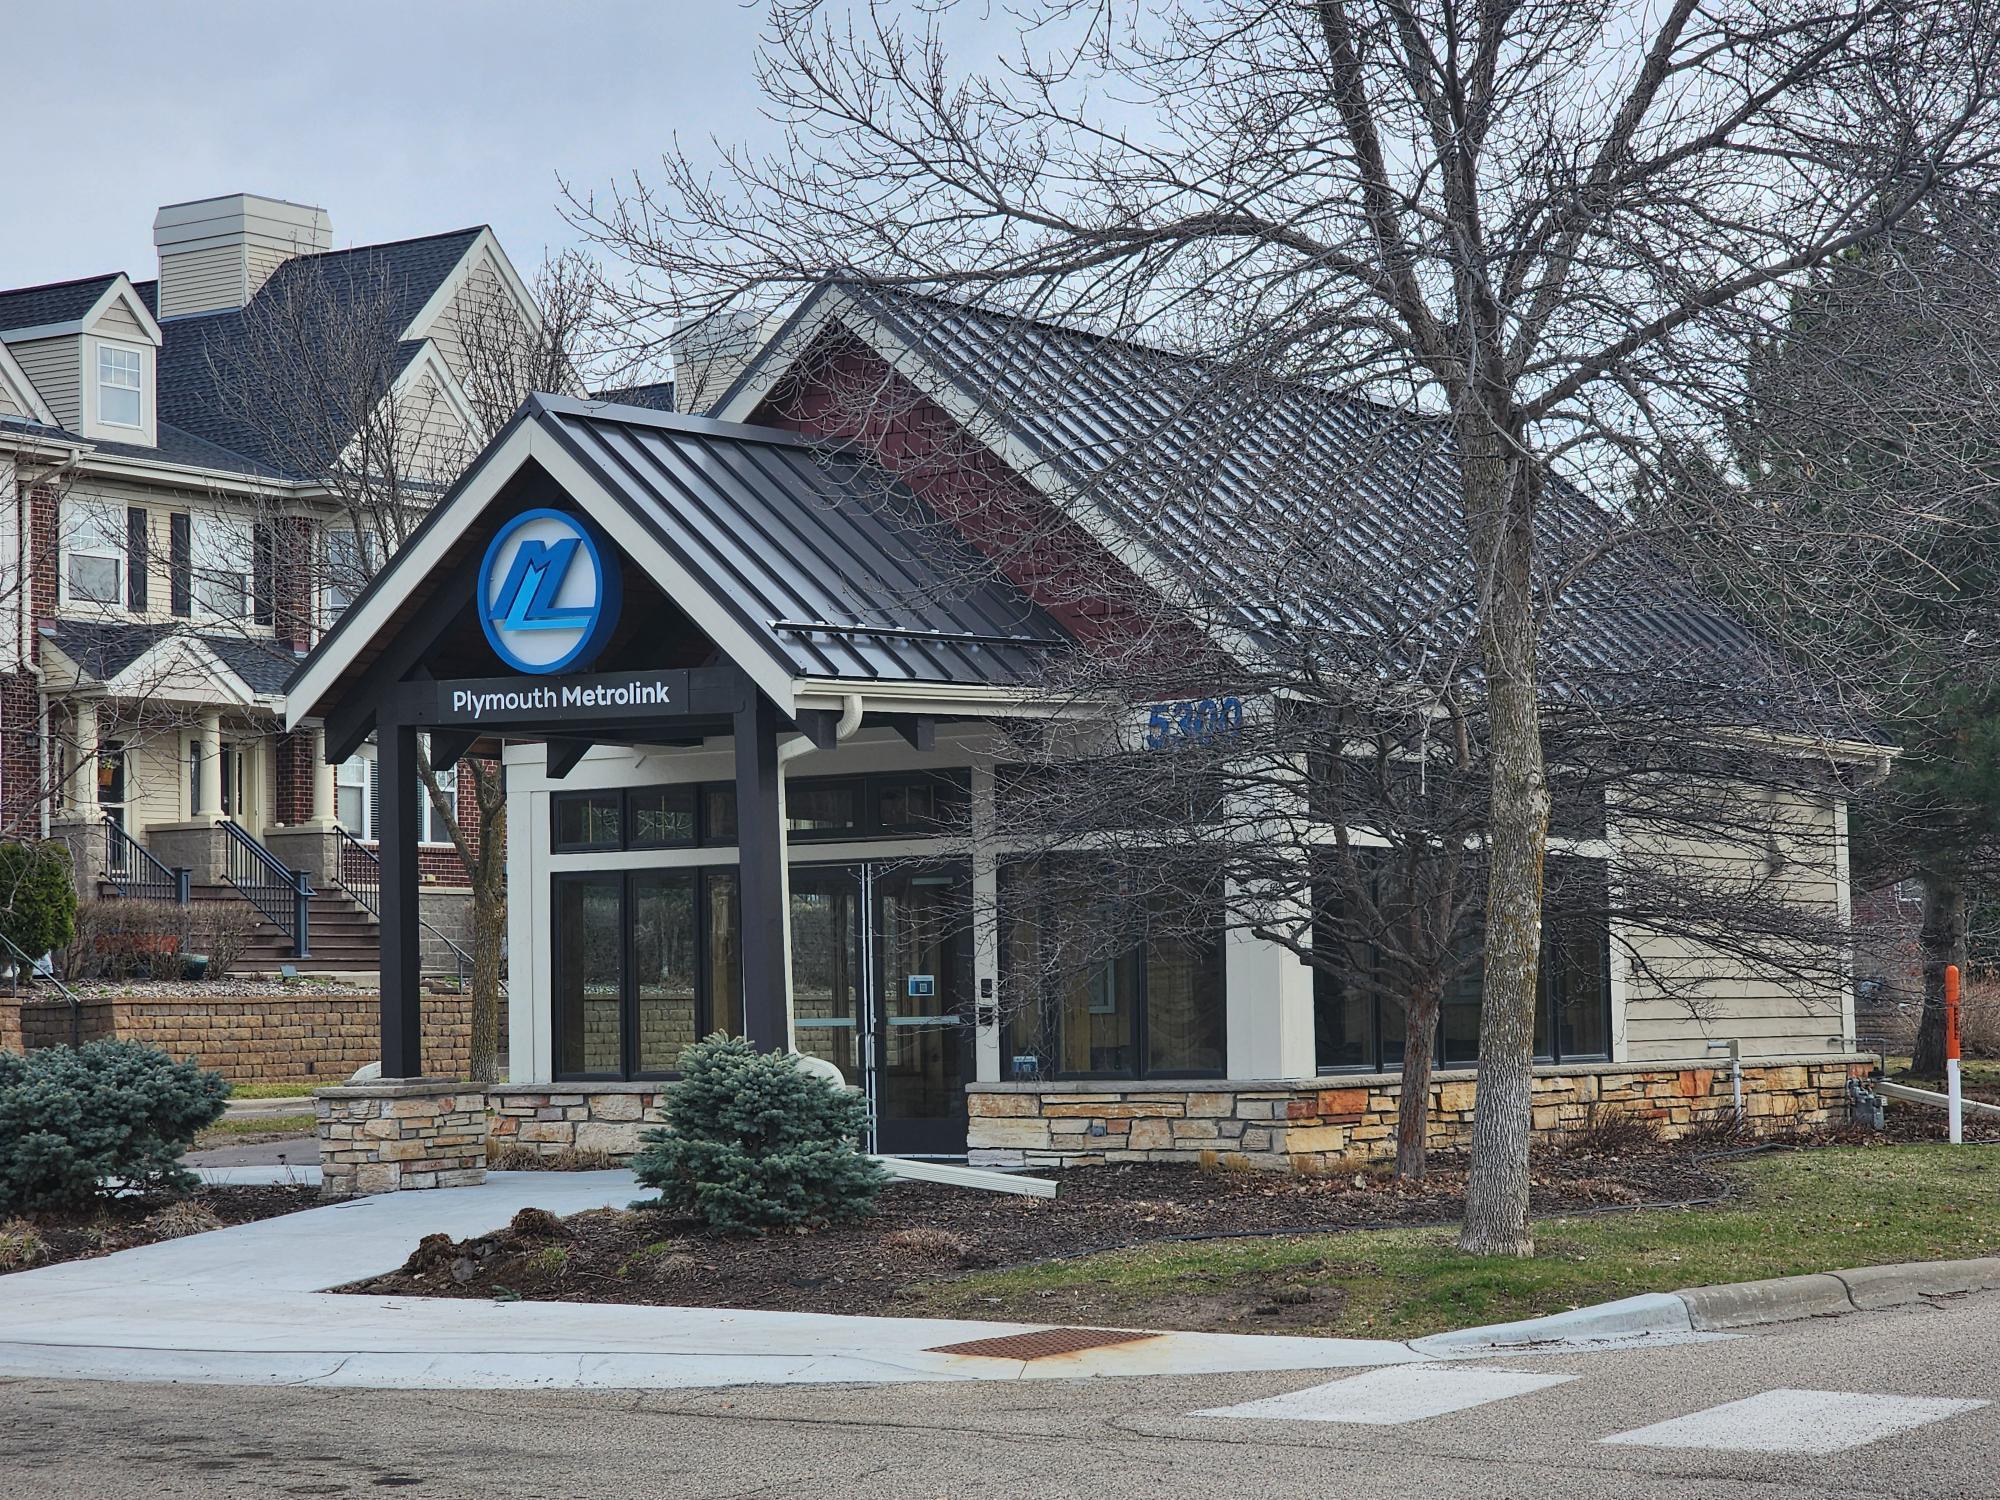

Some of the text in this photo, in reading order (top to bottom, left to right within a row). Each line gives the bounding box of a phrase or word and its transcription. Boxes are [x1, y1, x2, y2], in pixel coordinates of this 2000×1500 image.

[489, 538, 595, 632] ML
[453, 681, 670, 719] Plymouth Metrolink
